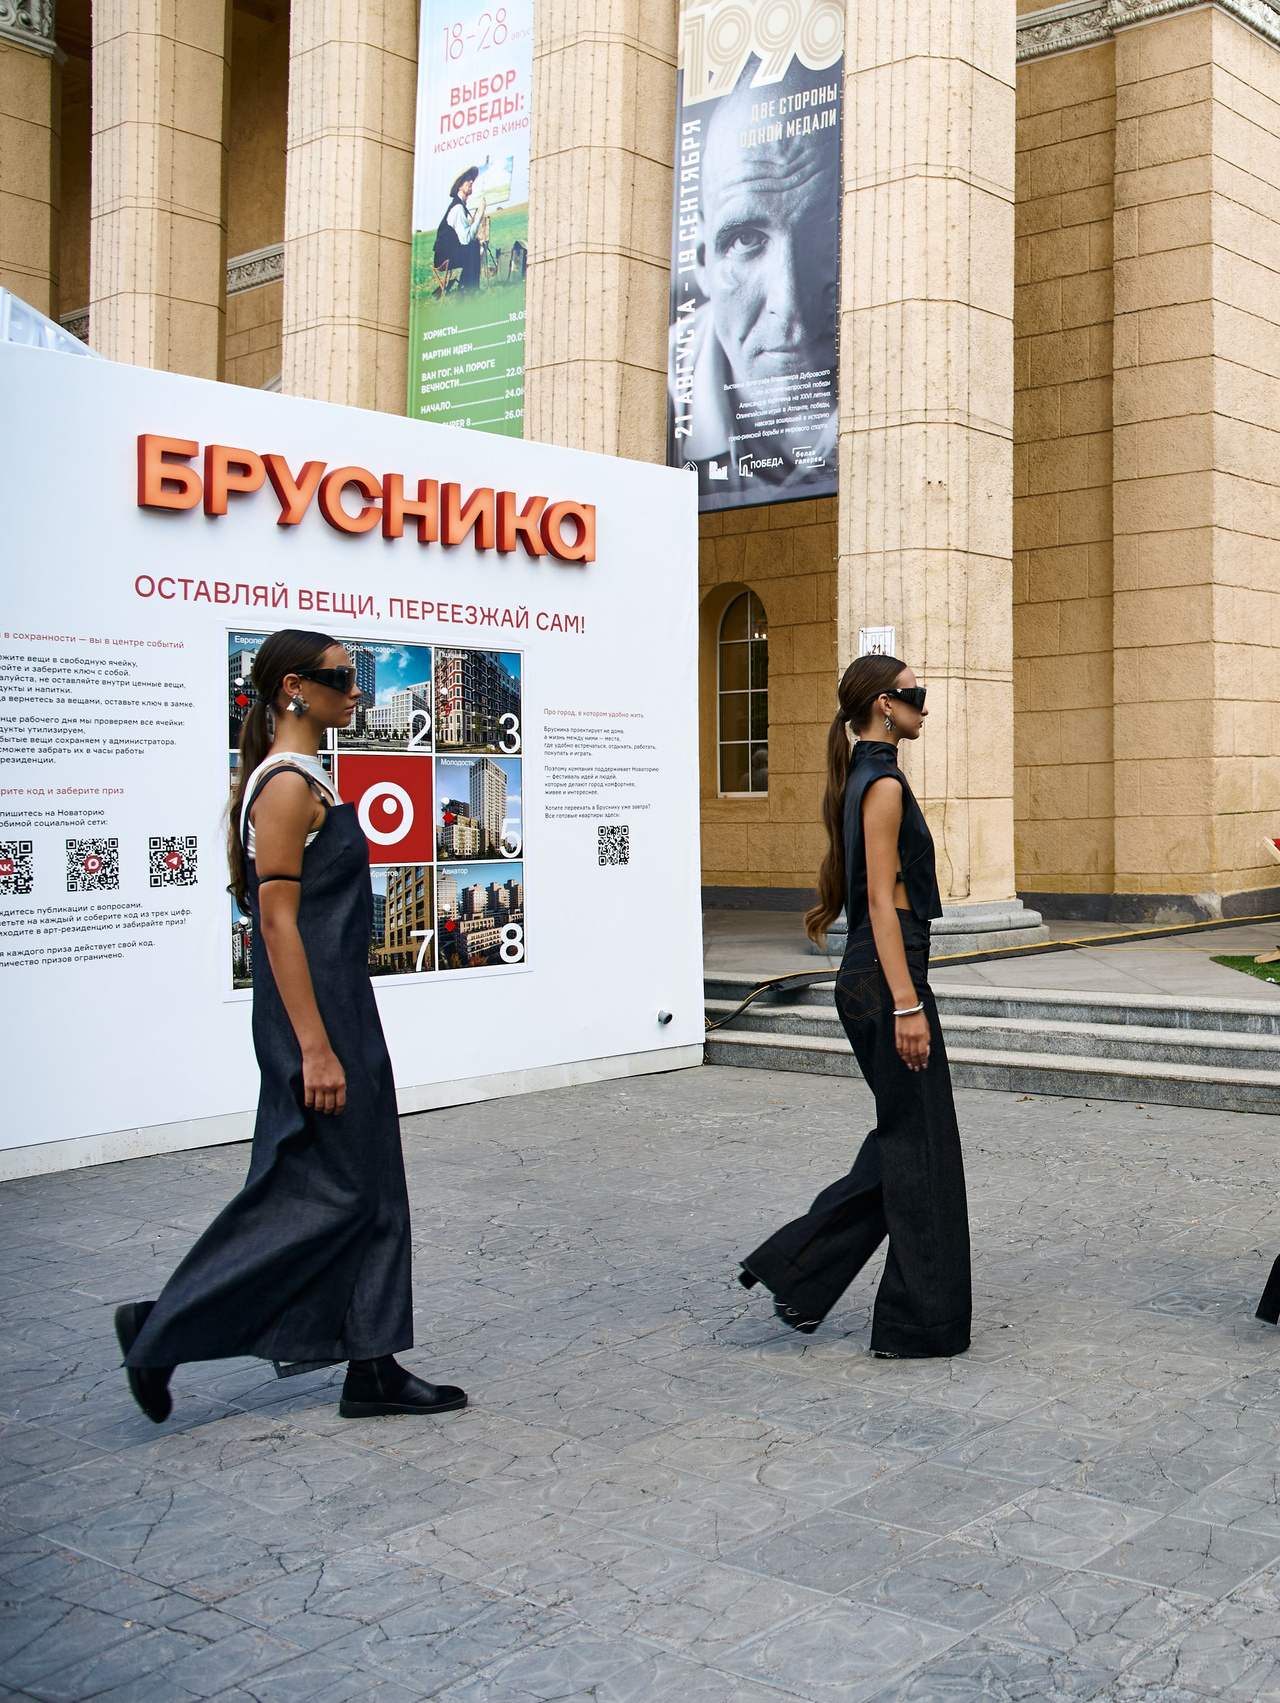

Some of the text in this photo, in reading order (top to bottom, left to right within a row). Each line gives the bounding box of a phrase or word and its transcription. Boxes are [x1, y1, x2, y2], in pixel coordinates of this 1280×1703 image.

[444, 8, 507, 62] 18-28
[684, 0, 843, 98] 1990
[450, 70, 516, 107] ВЫБОР
[751, 83, 838, 122] ДВЕ СТОРОНЫ
[440, 93, 524, 134] ПОБЕДЫ:
[434, 117, 529, 154] ИСКУССТВО В КИНО
[740, 108, 836, 148] ОДНОЙ МЕДАЛИ
[679, 119, 701, 242] СЕНТЯБРЯ
[678, 248, 697, 274] 19
[423, 326, 458, 341] ХОРИСТЫ
[422, 348, 451, 361] МАРТИН
[453, 343, 473, 355] ИДЕН
[676, 298, 696, 404] АВГУСТА
[422, 359, 495, 382] ВАН ГОГ. НА ПОРОГЕ
[422, 379, 460, 394] ВЕЧНОСТИ
[421, 401, 451, 414] НАЧАЛО
[675, 414, 693, 439] 21
[751, 456, 784, 470] ПОБЕДА
[135, 574, 585, 634] ОСТАВЛЯЙ ВЕЩИ, ПЕРЕЕЗЖАЙ САМ!
[12, 632, 76, 642] сохранности
[112, 639, 145, 648] центре
[146, 639, 184, 649] событий
[27, 656, 51, 664] вещи
[59, 657, 107, 667] свободную
[32, 665, 72, 675] заберите
[51, 677, 100, 685] оставляйте
[102, 679, 130, 687] внутри
[9, 696, 54, 704] вернетесь
[19, 715, 60, 724] рабочего
[94, 718, 139, 726] проверяем
[407, 710, 431, 751] 2
[499, 713, 520, 754] 3
[55, 737, 100, 745] сохраняем
[38, 746, 72, 755] забрать
[115, 747, 144, 756] работы
[0, 757, 56, 765] резиденции.
[27, 788, 45, 796] код
[56, 786, 100, 796] заберите
[102, 788, 124, 796] приз
[57, 809, 105, 817] Новаторию
[34, 818, 85, 827] социальной
[500, 818, 522, 858] 5
[371, 870, 398, 878] бристов
[37, 906, 88, 915] публикации
[40, 915, 74, 924] каждый
[83, 913, 122, 922] соберите
[43, 923, 114, 935] арт-резиденцию
[123, 919, 164, 929] забирайте
[7, 948, 45, 957] каждого
[46, 946, 72, 955] приза
[74, 943, 116, 953] действует
[118, 940, 137, 949] свой
[409, 930, 434, 971] 7
[500, 922, 524, 963] 8
[42, 956, 72, 966] призов
